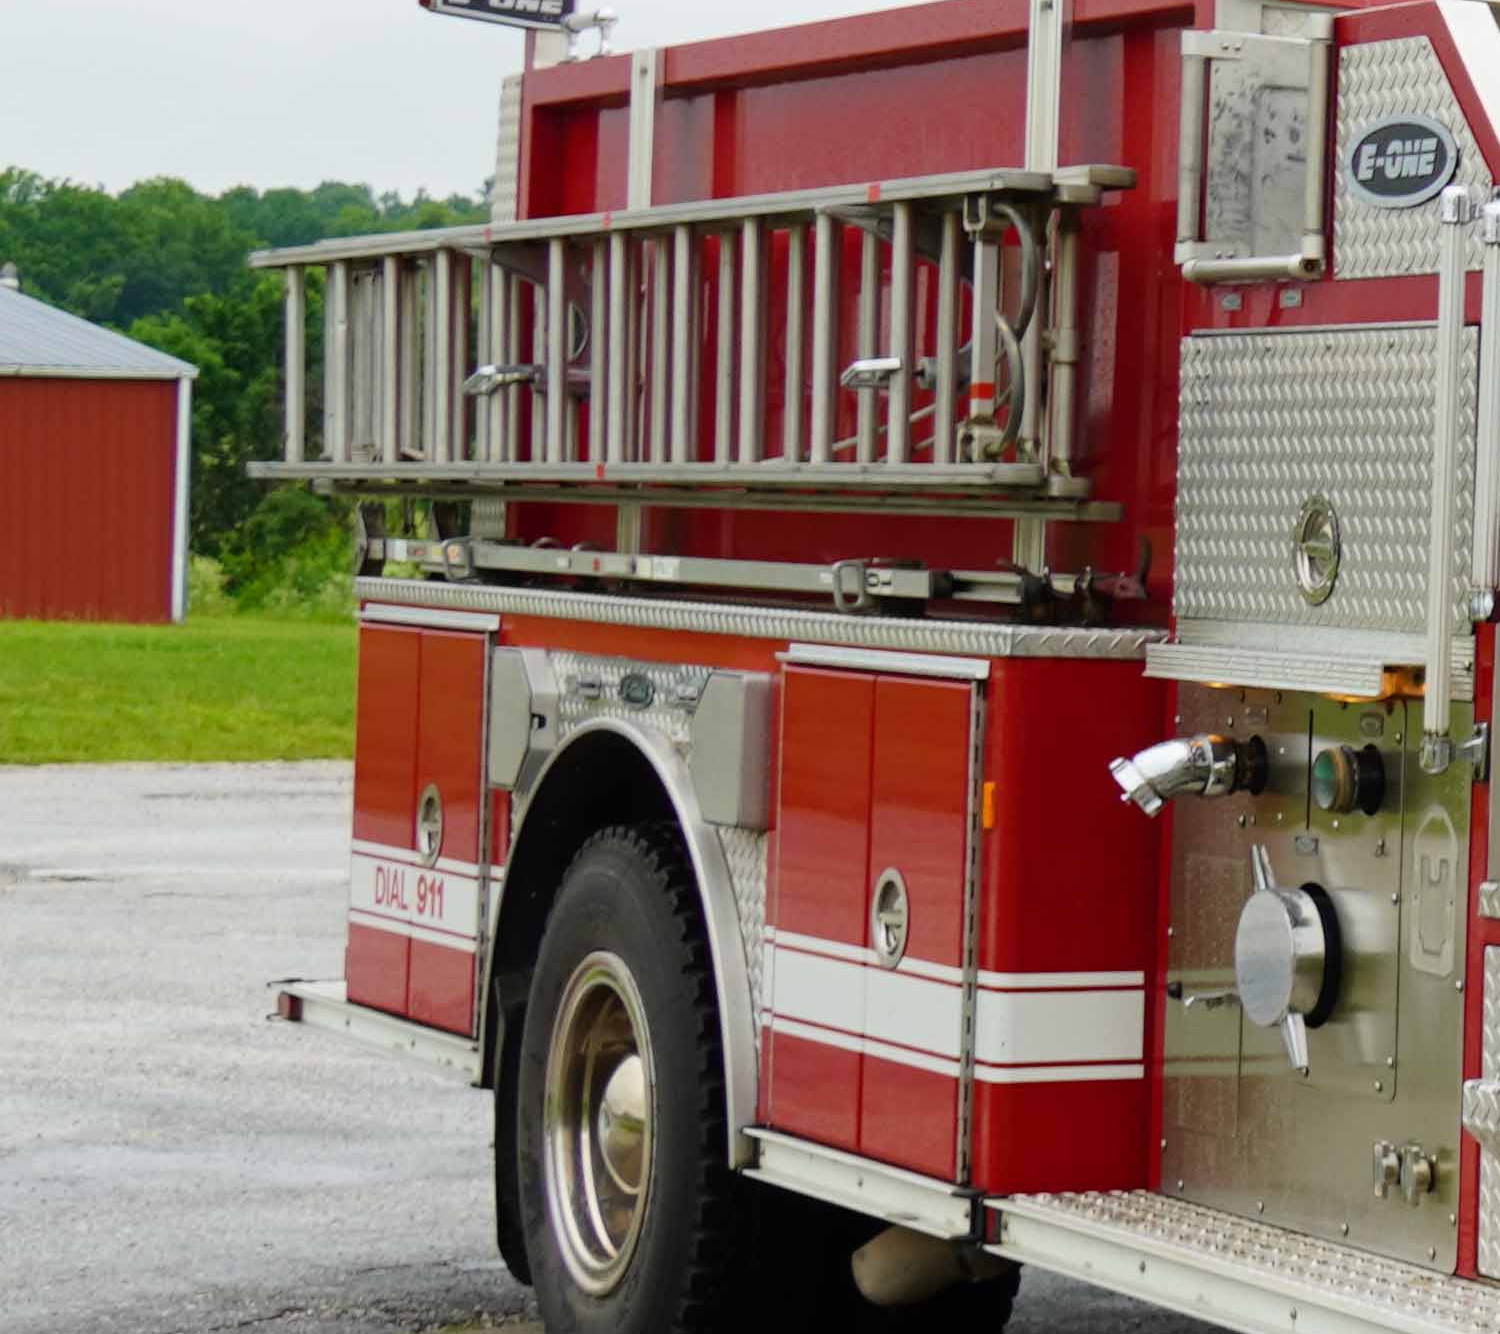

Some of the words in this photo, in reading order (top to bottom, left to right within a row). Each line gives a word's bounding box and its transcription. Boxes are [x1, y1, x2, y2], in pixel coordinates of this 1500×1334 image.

[1357, 137, 1439, 181] E-ONE
[374, 865, 408, 911] DIAL
[416, 874, 445, 919] 911
